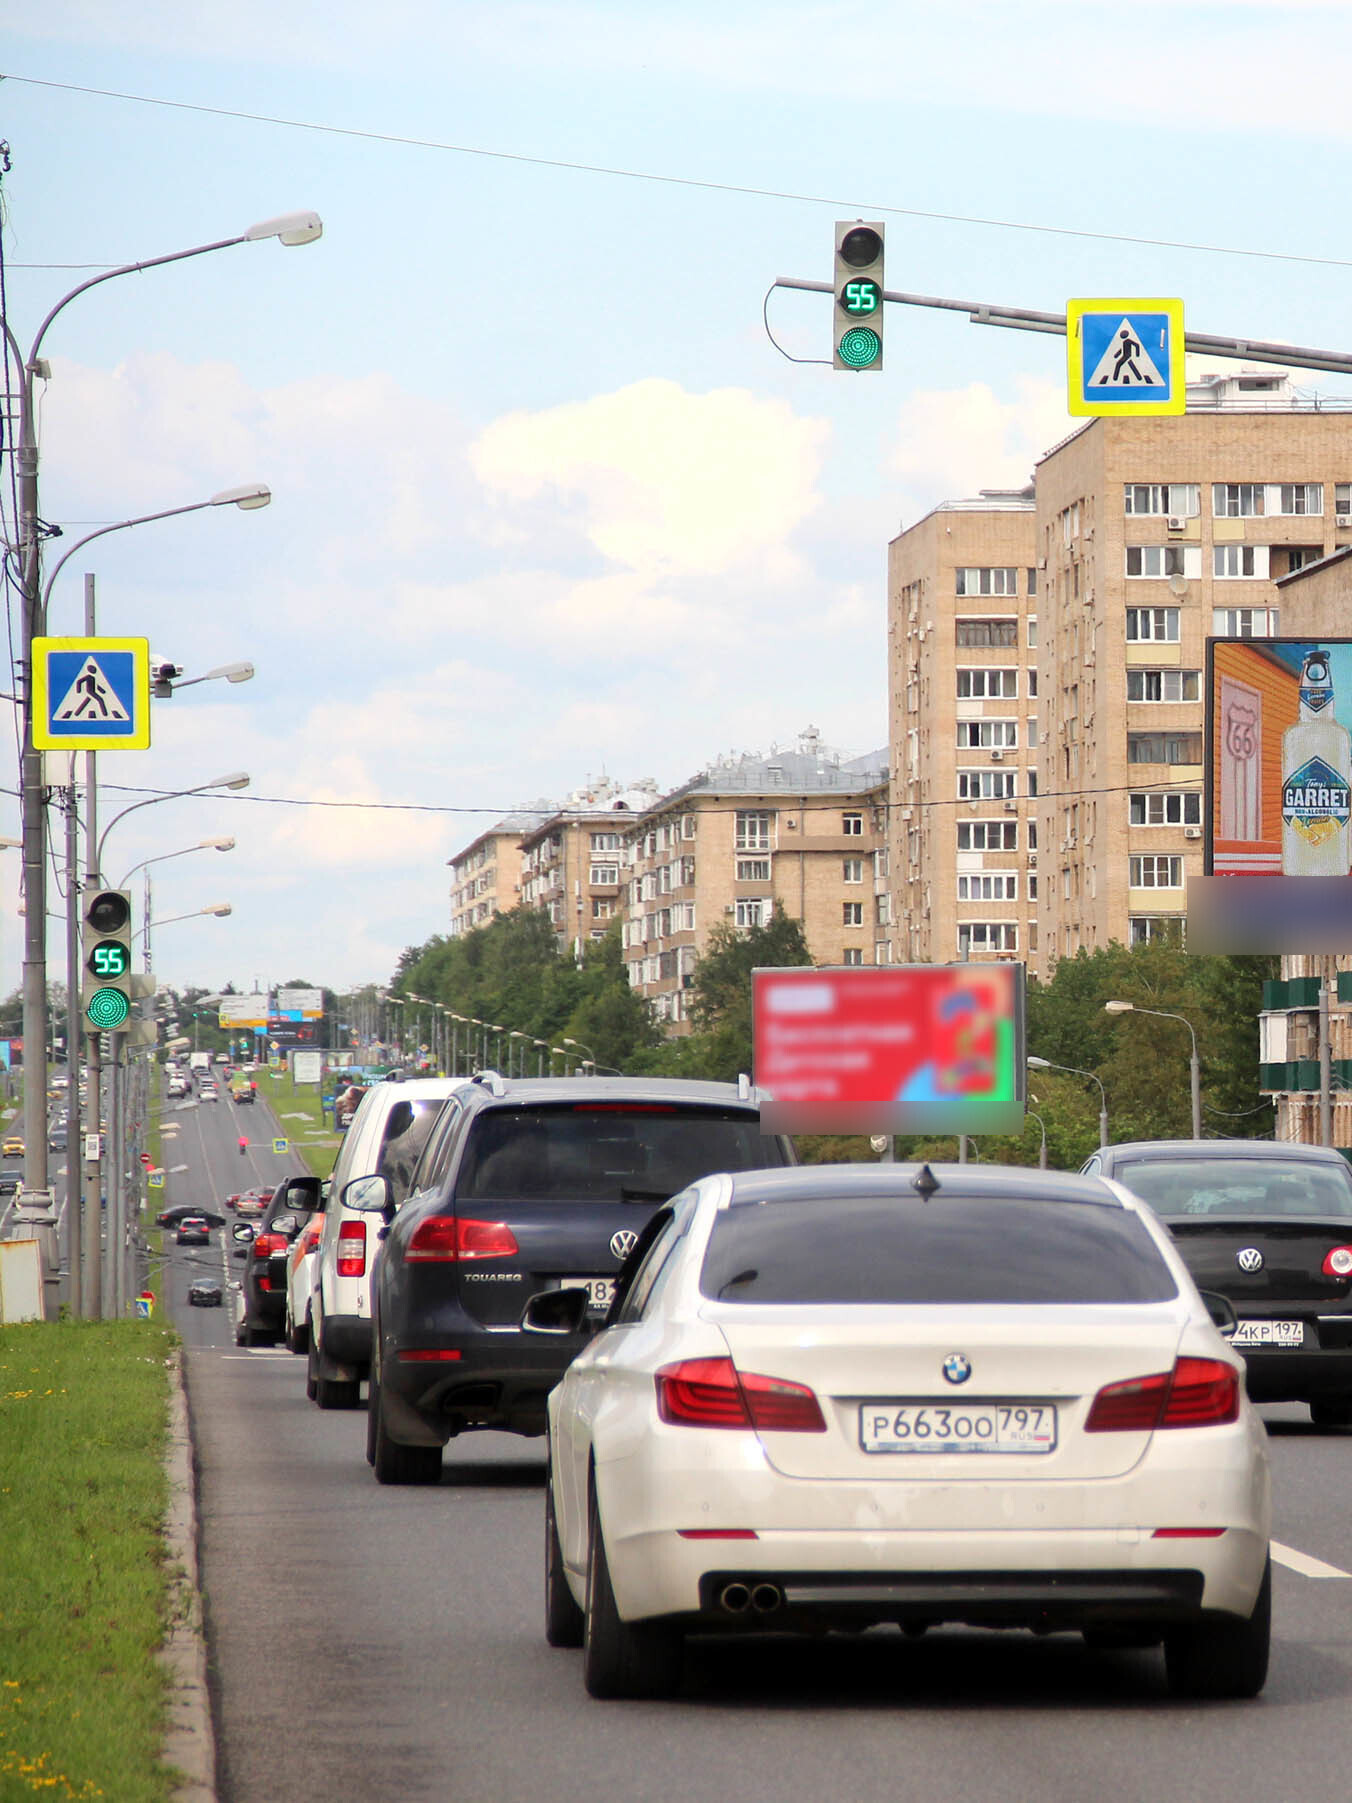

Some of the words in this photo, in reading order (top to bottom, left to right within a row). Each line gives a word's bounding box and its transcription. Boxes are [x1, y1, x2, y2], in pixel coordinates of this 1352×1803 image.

[847, 284, 874, 309] 55
[1232, 724, 1252, 755] 66
[1285, 788, 1348, 807] GARRET
[95, 948, 123, 973] 55
[464, 1273, 522, 1283] TOUAREG
[584, 1281, 616, 1302] 18
[1231, 1323, 1270, 1339] 4КР
[1274, 1322, 1299, 1335] 197
[873, 1409, 993, 1439] Р663ОО
[999, 1408, 1045, 1431] 797
[1010, 1431, 1033, 1441] RUS
